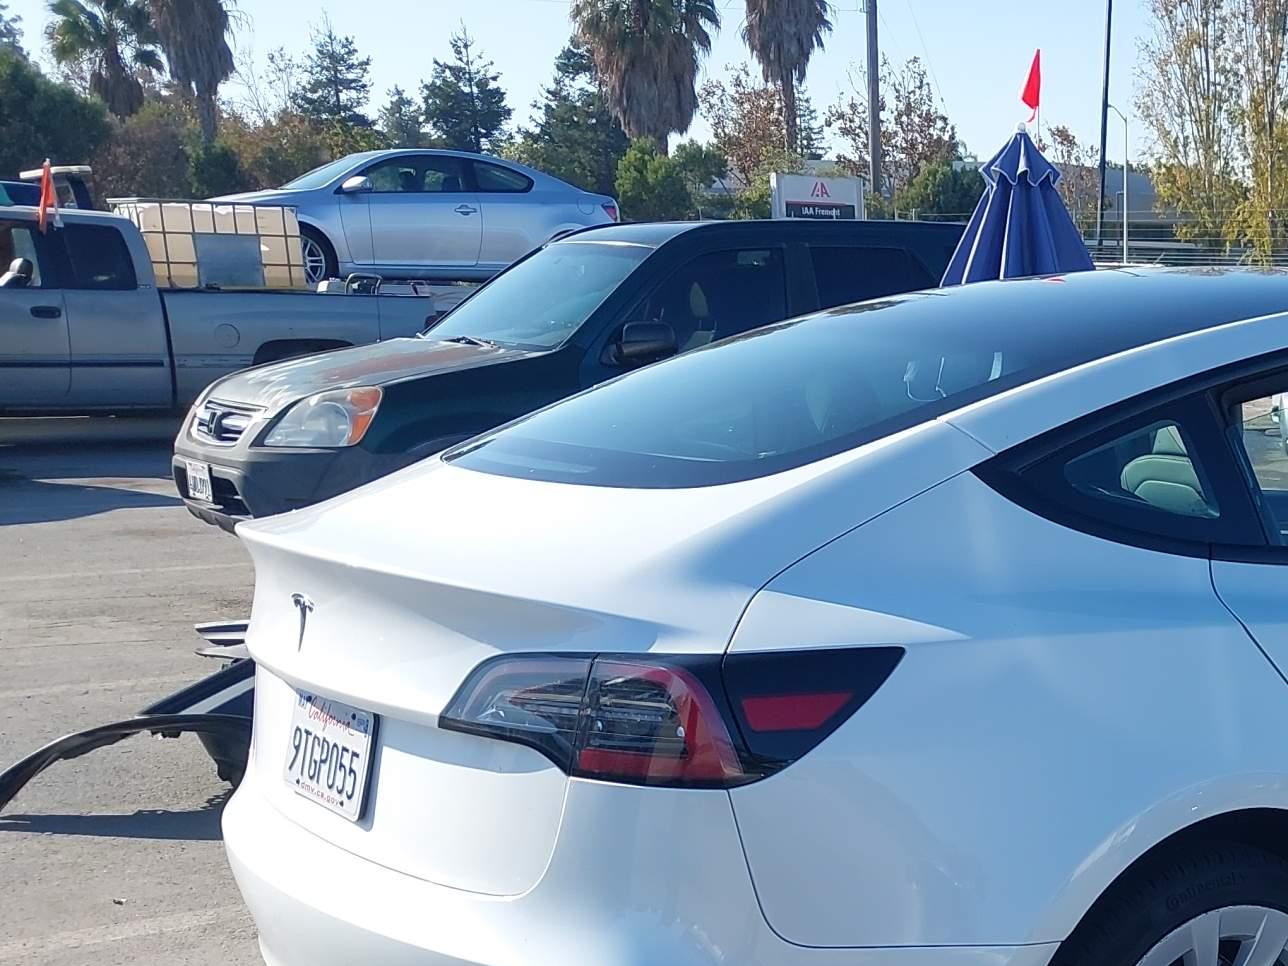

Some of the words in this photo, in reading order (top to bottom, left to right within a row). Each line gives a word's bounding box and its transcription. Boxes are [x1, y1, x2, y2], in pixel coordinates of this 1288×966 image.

[802, 206, 815, 215] IAA
[308, 696, 354, 736] California
[288, 725, 360, 800] 9TGP055
[301, 782, 340, 805] dmv.ca.gov
